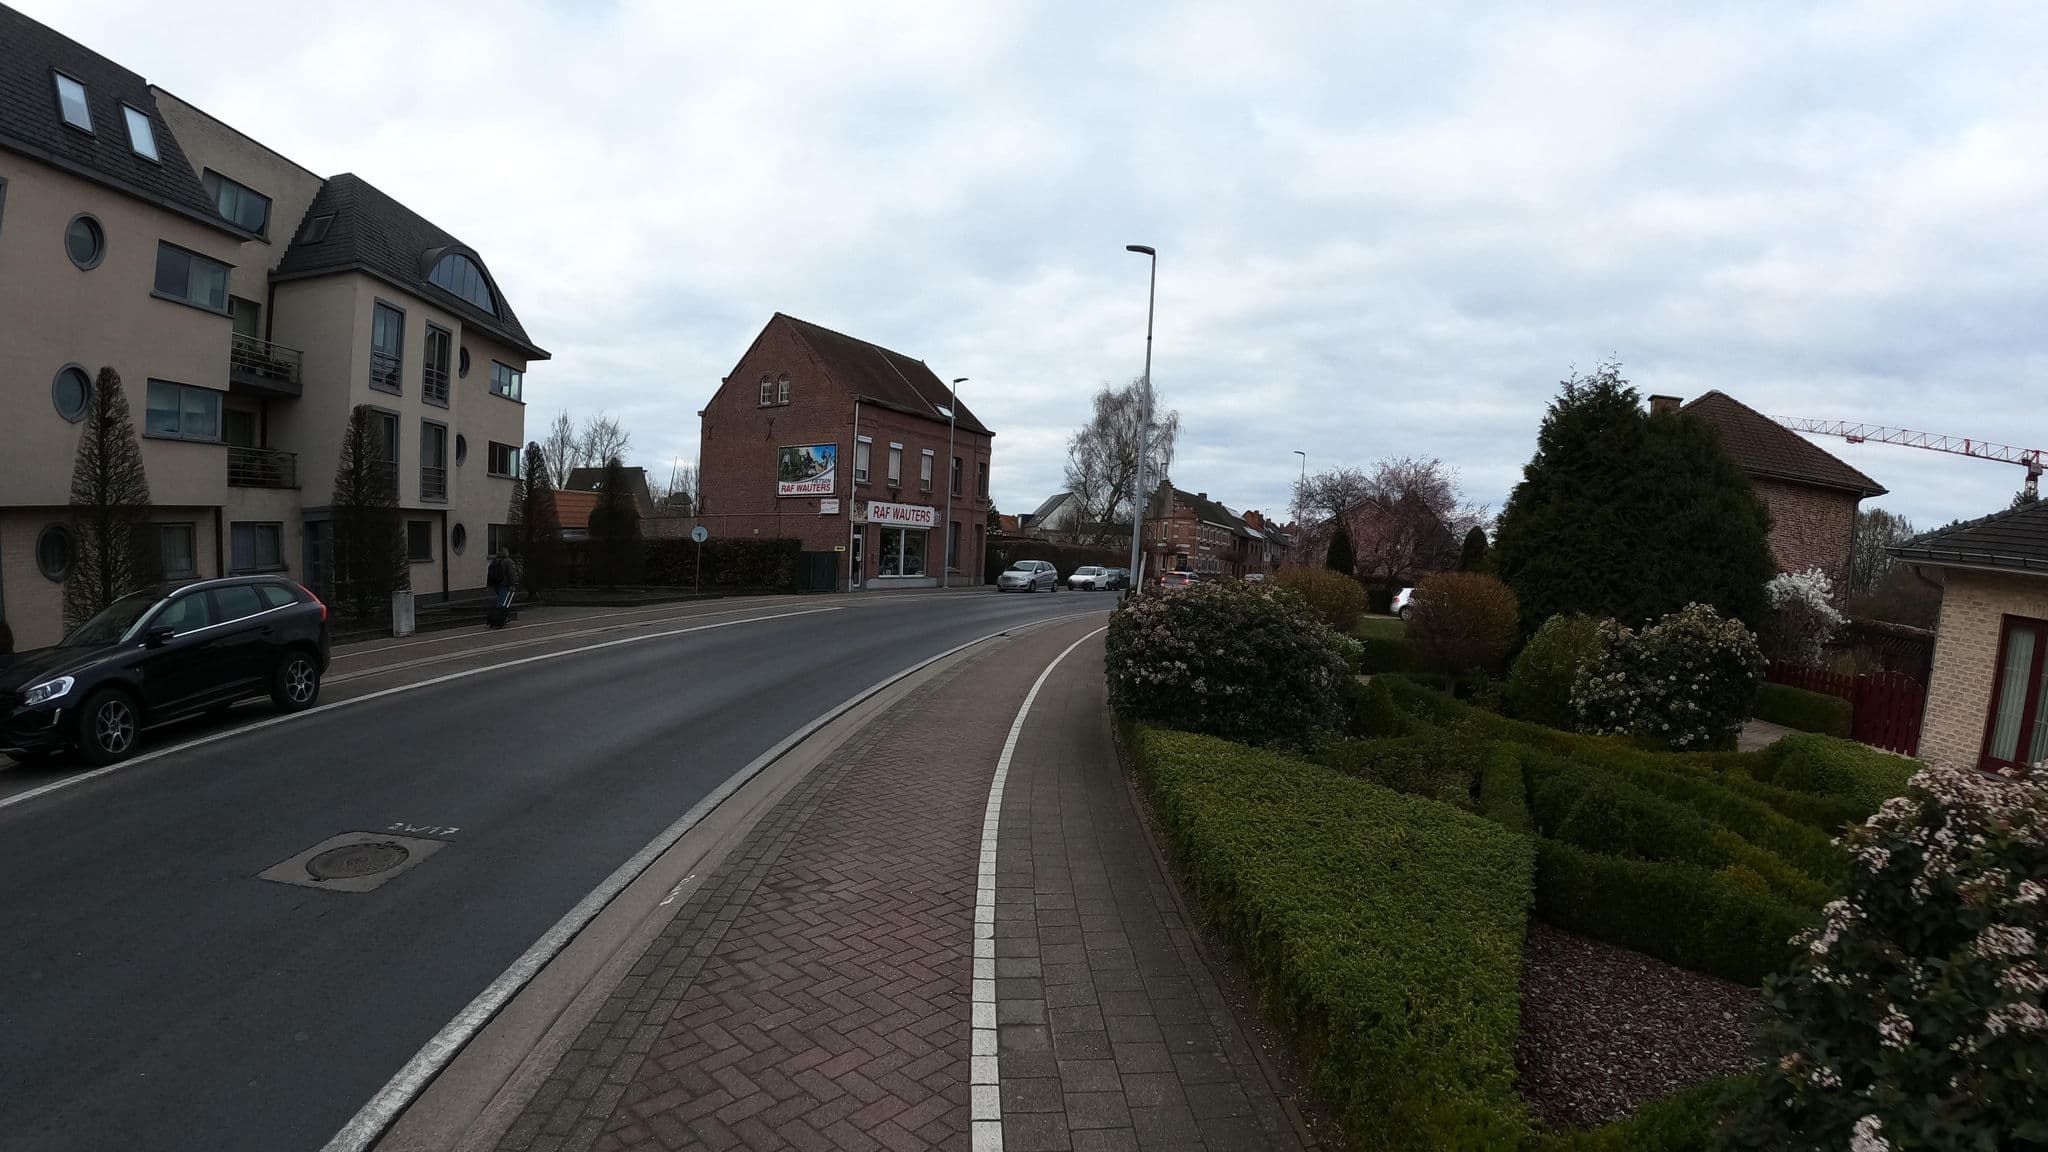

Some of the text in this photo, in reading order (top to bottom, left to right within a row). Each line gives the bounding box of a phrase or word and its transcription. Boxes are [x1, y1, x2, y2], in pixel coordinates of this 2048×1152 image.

[781, 483, 832, 493] RAF WAUTERS
[873, 505, 932, 523] RAF WAUTERS
